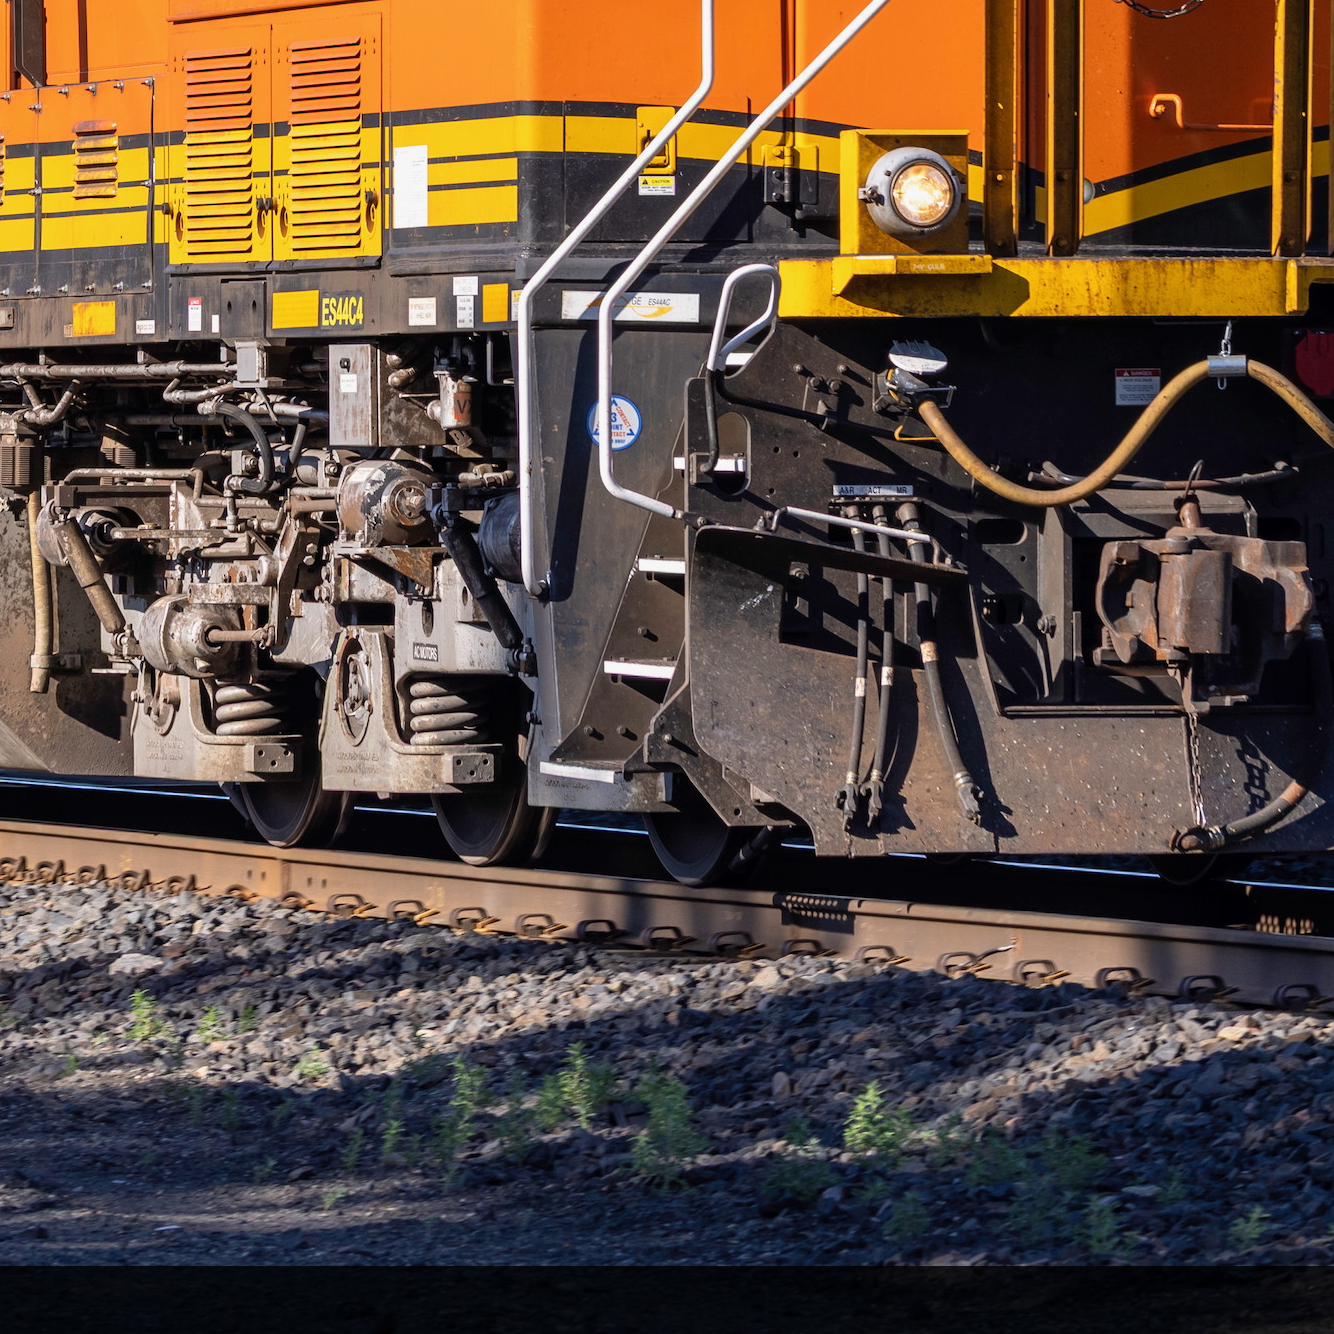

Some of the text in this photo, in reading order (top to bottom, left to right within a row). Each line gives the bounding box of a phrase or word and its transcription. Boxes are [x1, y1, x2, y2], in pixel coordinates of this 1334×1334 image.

[632, 297, 671, 306] GE ES44AC
[322, 296, 364, 326] ES44C4
[868, 486, 882, 494] ACT
[896, 486, 907, 494] MR
